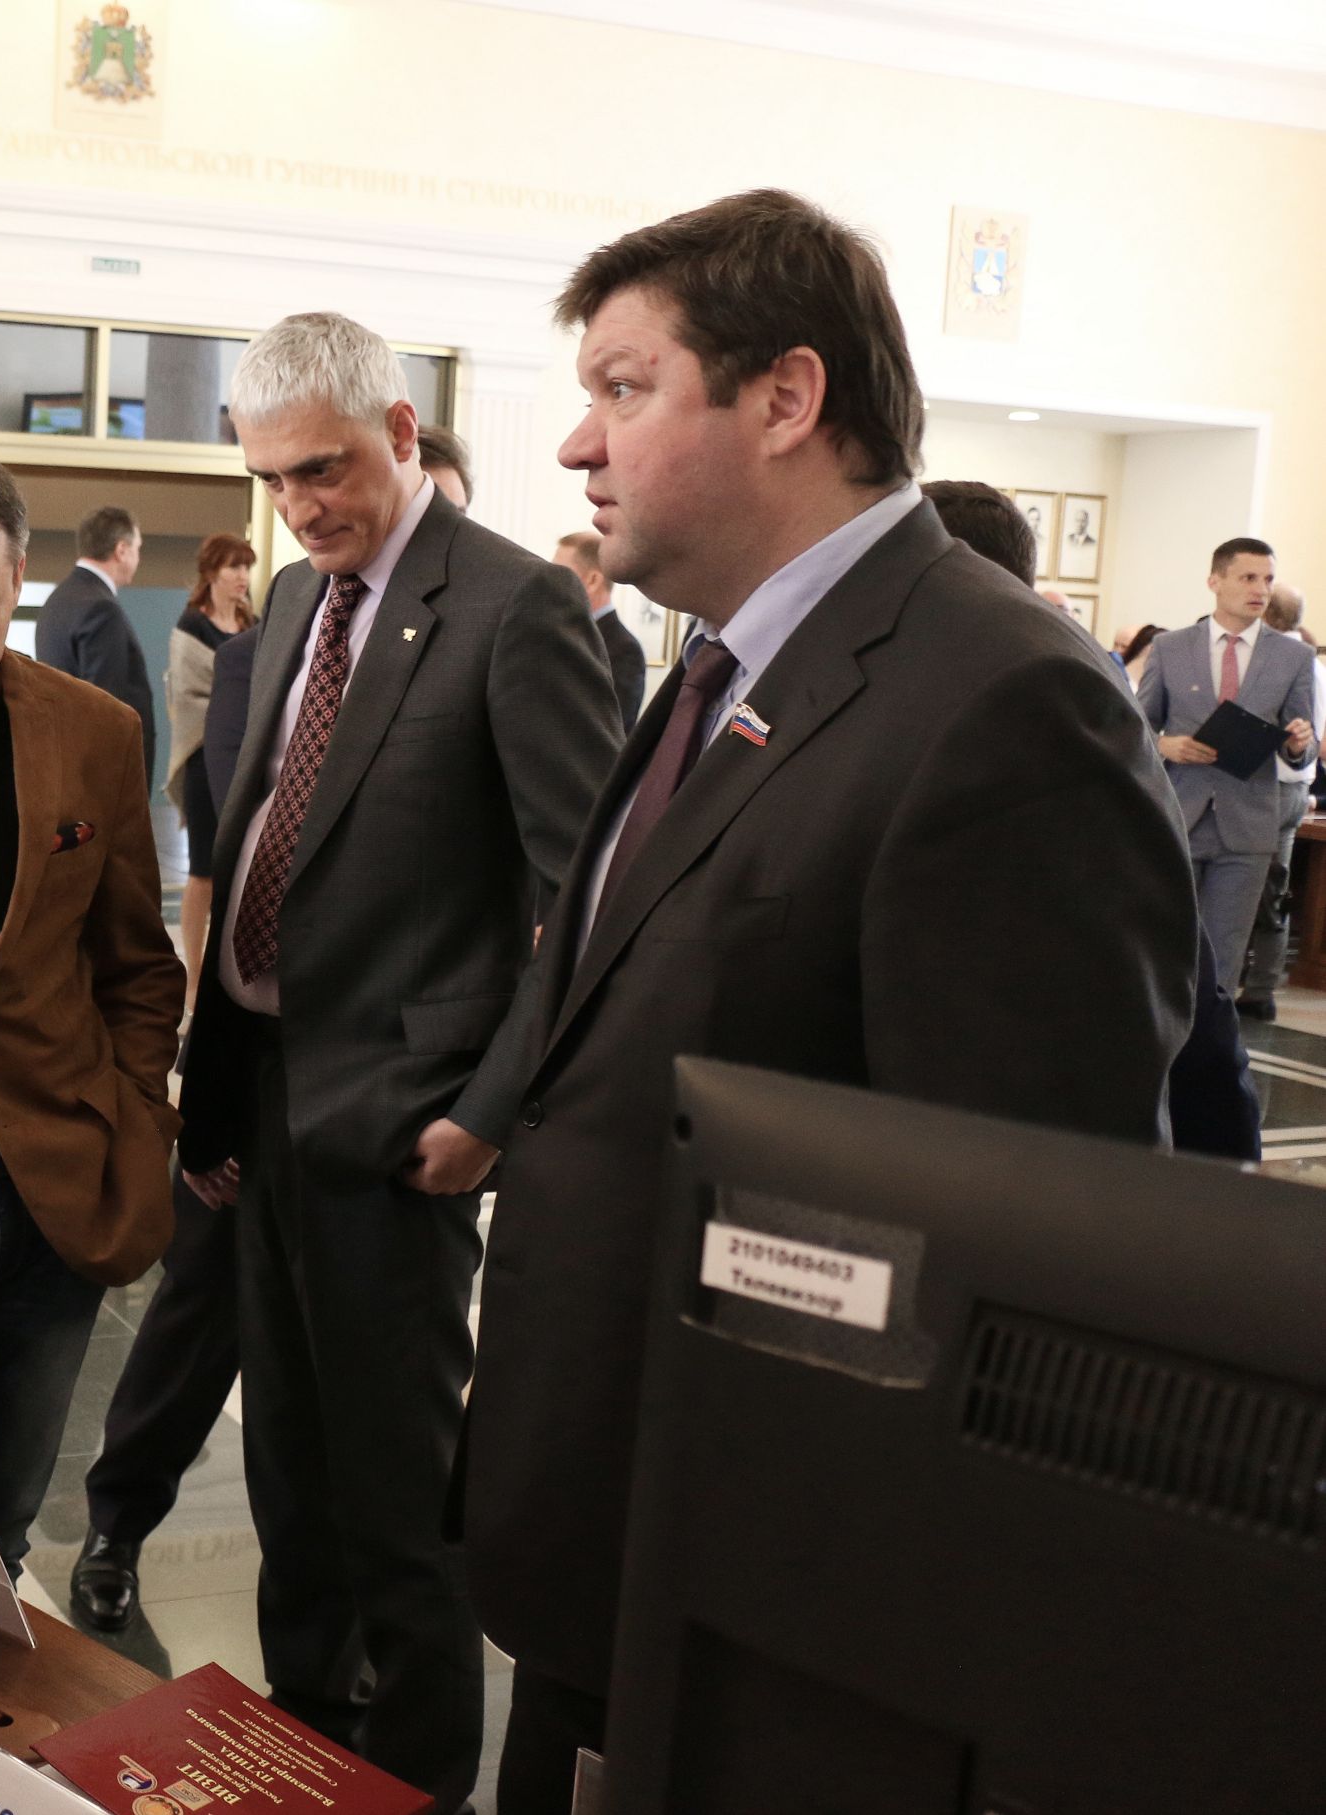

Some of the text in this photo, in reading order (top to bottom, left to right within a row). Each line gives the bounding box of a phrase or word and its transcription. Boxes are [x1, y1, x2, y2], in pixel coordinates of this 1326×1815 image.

[256, 1710, 274, 1723] 2014
[185, 1737, 231, 1772] Федерации
[186, 1708, 334, 1805] Владимира Владимировича
[220, 1745, 273, 1783] ПУТИНА
[175, 1762, 241, 1805] ВИЗИТ
[199, 1758, 249, 1793] Президента
[231, 1770, 282, 1803] Российской
